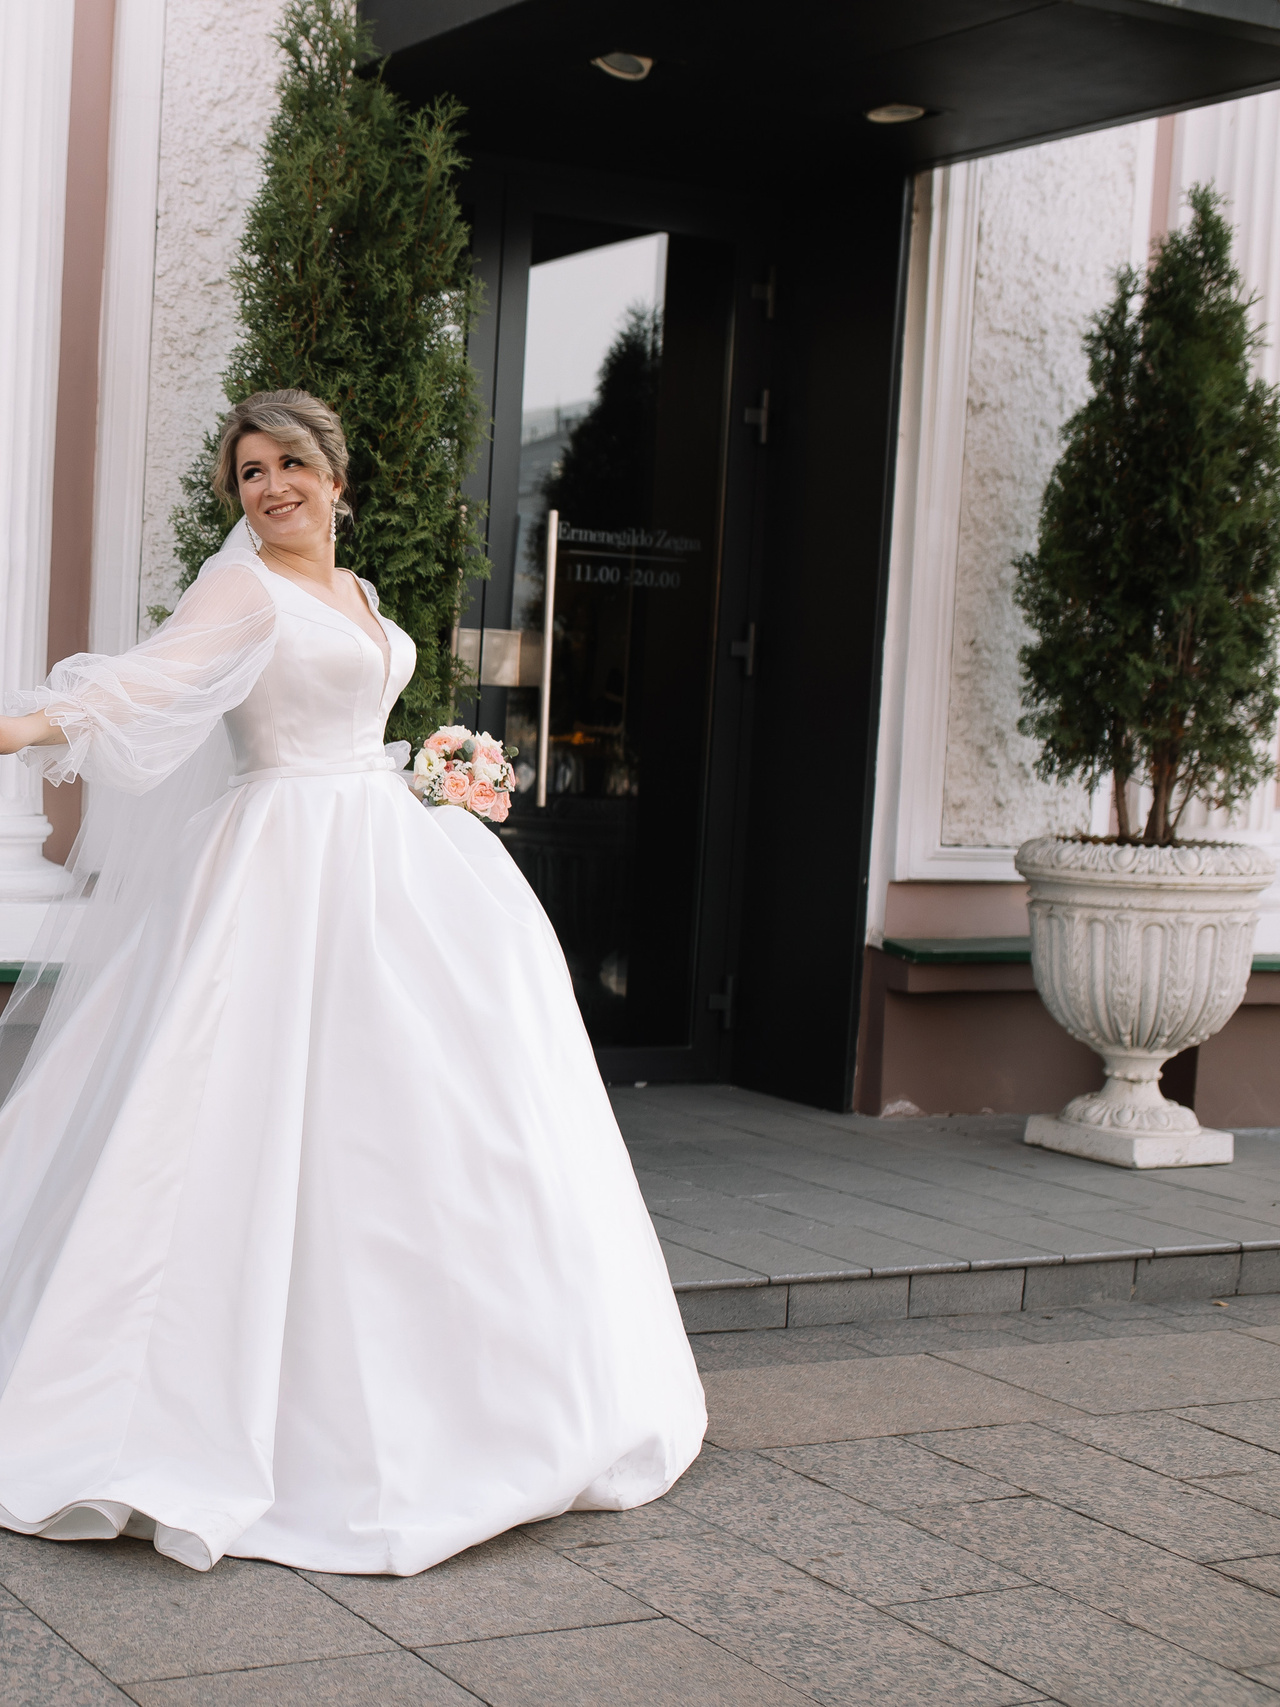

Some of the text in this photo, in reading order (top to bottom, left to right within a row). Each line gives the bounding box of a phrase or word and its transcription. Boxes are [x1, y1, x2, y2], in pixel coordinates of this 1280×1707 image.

[558, 520, 703, 555] Ermenegildo Zegna
[576, 563, 621, 584] 11.00
[634, 569, 681, 589] 20.00
